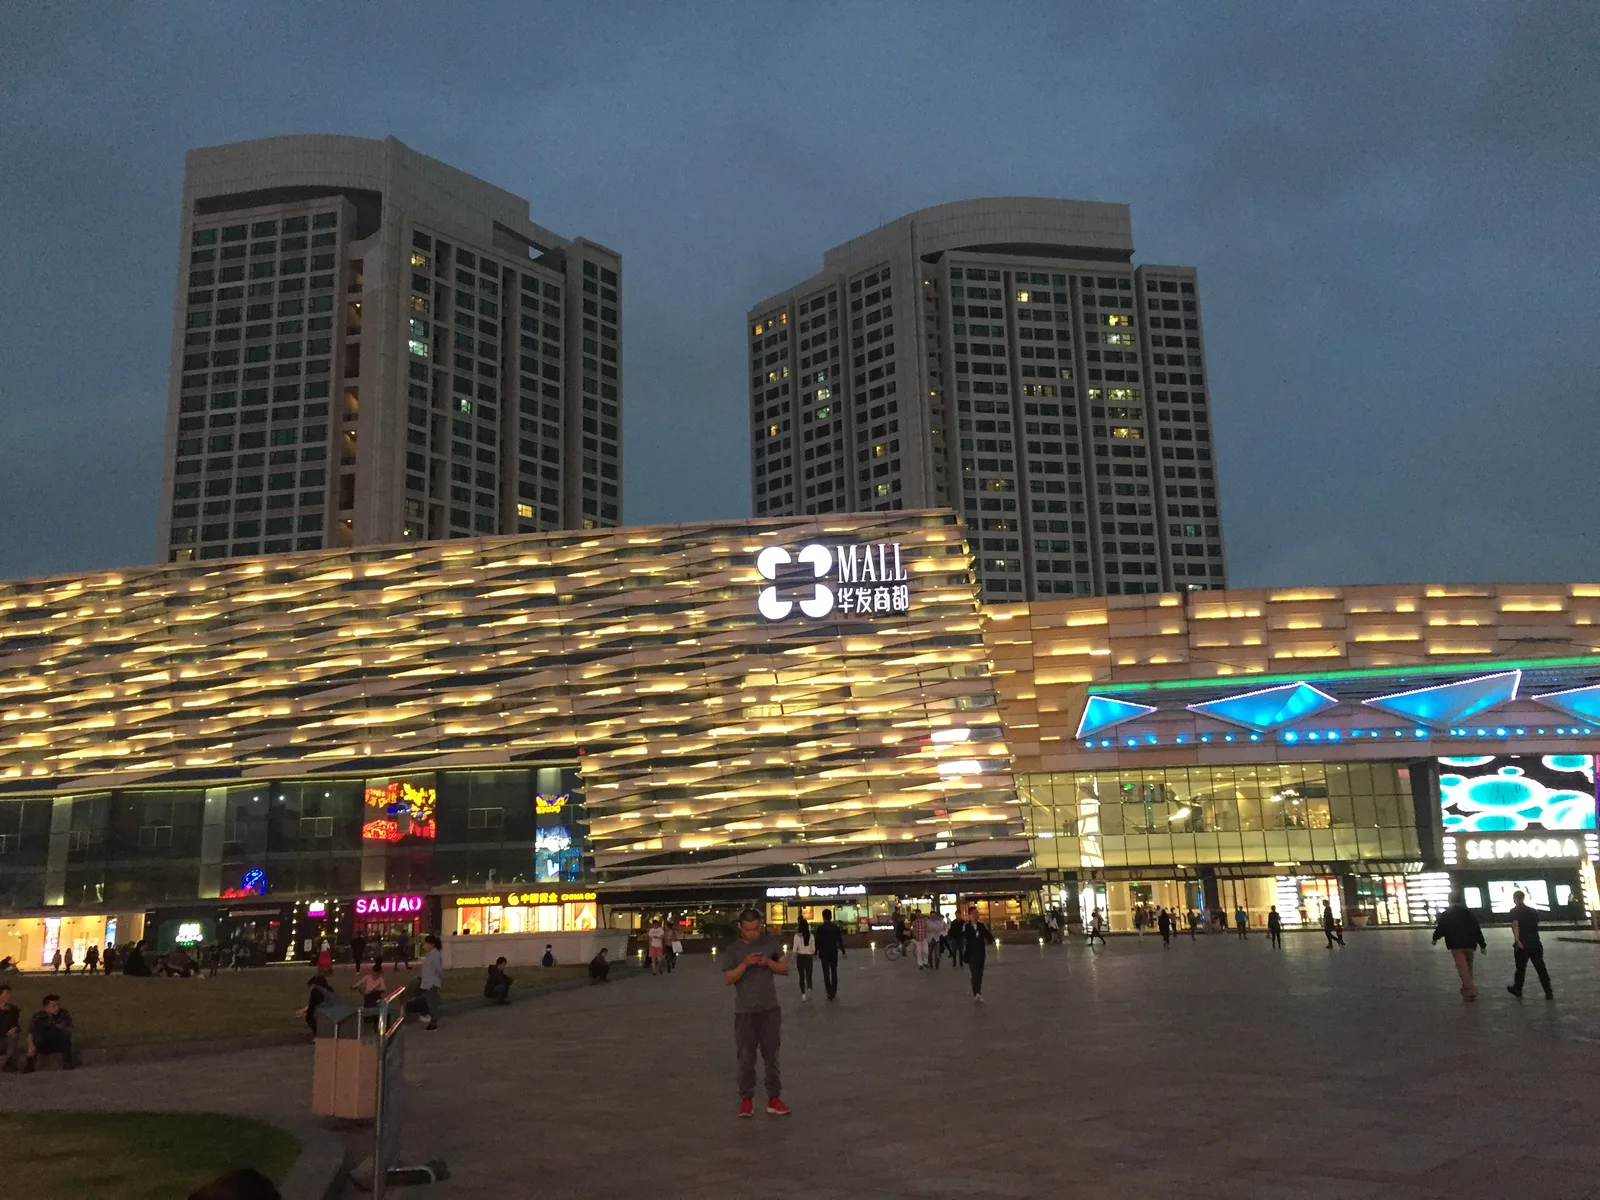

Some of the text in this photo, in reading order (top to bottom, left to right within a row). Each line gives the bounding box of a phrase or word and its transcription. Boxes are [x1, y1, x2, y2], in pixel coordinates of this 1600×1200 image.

[836, 543, 907, 583] MALL
[837, 585, 909, 614] 华发商都
[1465, 838, 1579, 860] SEPHORA
[355, 896, 422, 914] SAJIAO
[456, 897, 479, 906] CHINA
[561, 893, 584, 902] CHINA
